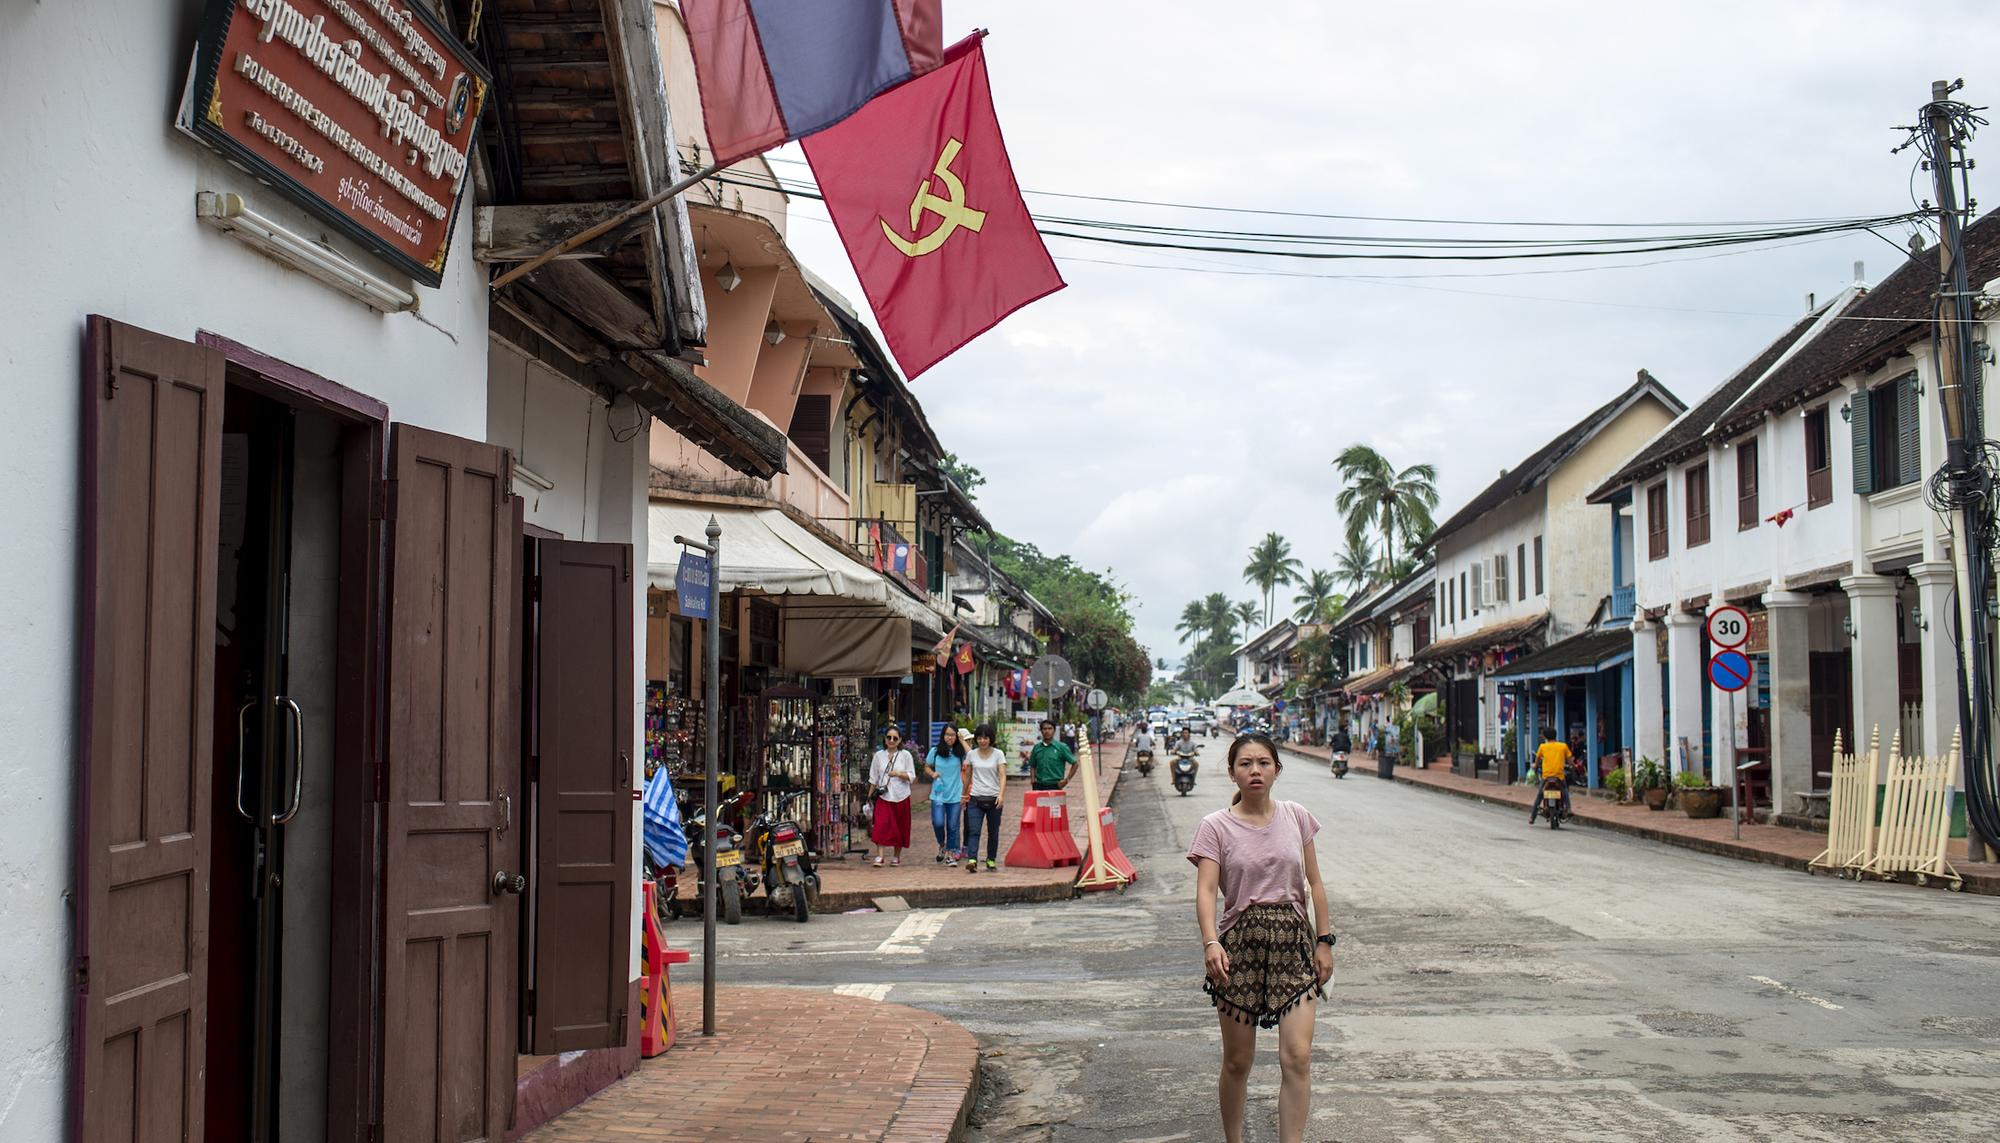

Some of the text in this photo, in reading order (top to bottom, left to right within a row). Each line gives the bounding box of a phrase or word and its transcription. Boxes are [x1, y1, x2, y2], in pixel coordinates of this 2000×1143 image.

[340, 1, 368, 35] CONTROL
[367, 27, 377, 43] OF
[376, 34, 396, 62] LUANG
[395, 54, 421, 87] PRABANG
[242, 54, 280, 95] POLICE
[313, 110, 351, 149] SERVICE
[349, 137, 381, 171] PEOPLE
[423, 195, 447, 221] GROUP
[1718, 620, 1740, 635] 30
